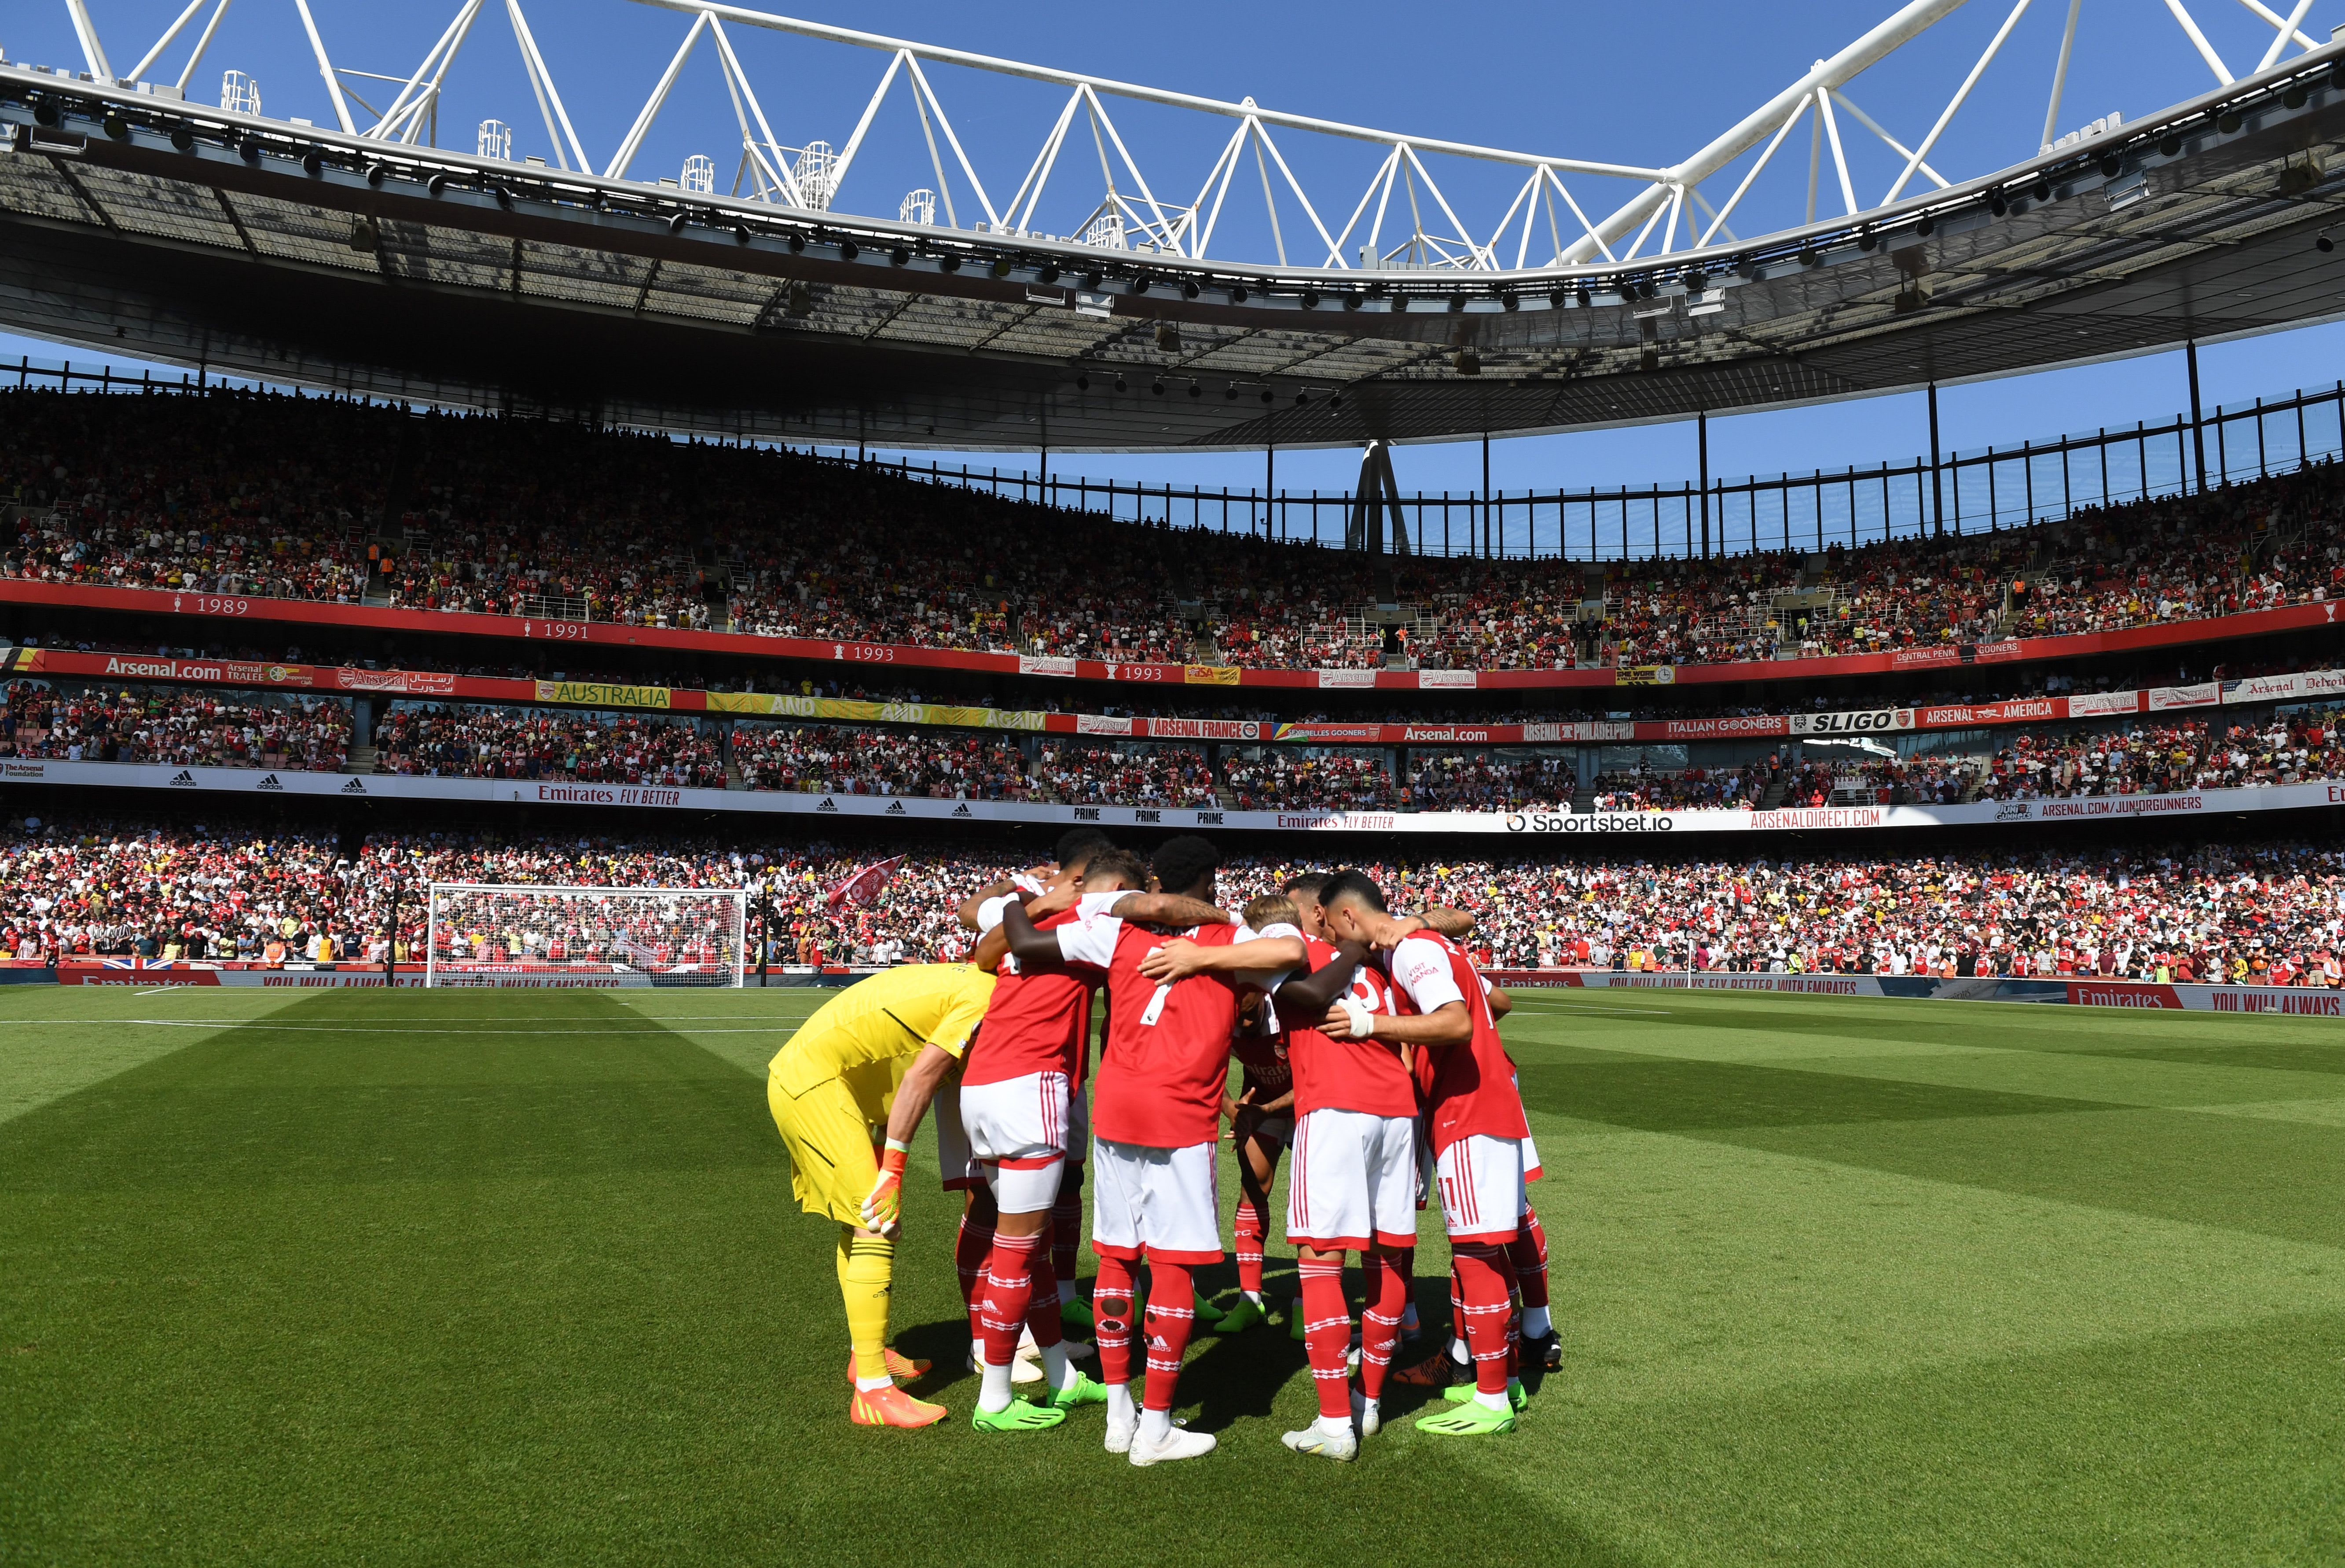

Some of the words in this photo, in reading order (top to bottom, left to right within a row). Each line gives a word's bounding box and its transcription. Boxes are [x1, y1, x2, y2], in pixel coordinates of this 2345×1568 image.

[198, 598, 247, 615] 1989
[544, 623, 588, 639] 1991
[854, 646, 893, 661] 1993
[1897, 653, 1931, 661] CENTRAL
[1933, 649, 1955, 658] PENN
[1979, 643, 2017, 654] GOONERS
[105, 657, 220, 680] Arsenal.com
[227, 663, 261, 672] Arsenal
[1035, 657, 1075, 670] Arsenal
[227, 671, 264, 681] TRALEE
[355, 670, 408, 686] Arsenal
[1125, 667, 1162, 680] 1993
[1334, 671, 1375, 682] Arsenal
[1433, 671, 1475, 682] Arsenal
[557, 683, 668, 706] AUSTRALIA
[2167, 685, 2216, 701] Arsenal
[2246, 679, 2294, 696] Arsenal
[2086, 692, 2136, 709] Arsenal
[709, 693, 765, 713] OVER
[770, 696, 815, 716] AND
[822, 699, 875, 720] OVER
[880, 704, 923, 723] AND
[929, 706, 979, 726] OVER
[984, 709, 1044, 730] AGAIN
[1927, 709, 1974, 723] ARSENAL
[2003, 702, 2052, 718] AMERICA
[1091, 717, 1131, 731] Arsenal
[1154, 720, 1200, 736] ARSENAL
[1202, 721, 1242, 738] FRANCE
[1669, 720, 1715, 733] ITALIAN
[1813, 712, 1891, 731] SLIGO
[1403, 727, 1487, 741] Arsenal.com
[1523, 724, 1561, 741] ARSENAL
[1574, 723, 1634, 741] PHILADELPHIA
[538, 785, 613, 803] Emirates
[620, 789, 639, 804] FLY
[641, 790, 679, 805] BETTER
[1074, 808, 1100, 820] PRIME
[2042, 796, 2202, 817] ARSENAL.COM/JUNIORGUNNERS
[1135, 810, 1161, 823] PRIME
[1197, 812, 1224, 825] PRIME
[1277, 815, 1338, 828] Emirates
[1343, 815, 1359, 828] FLY
[1361, 816, 1394, 829] BETTER
[1533, 814, 1673, 832] Sportsbet.io
[1750, 809, 1879, 829] ARSENALDIRECT.COM
[1408, 962, 1425, 977] VISIT
[1777, 979, 1803, 992] WITH
[1807, 980, 1856, 995] EMIRATES
[2077, 988, 2162, 1009] Emirates
[2282, 995, 2340, 1016] ALWAYS
[1438, 1177, 1457, 1211] 11
